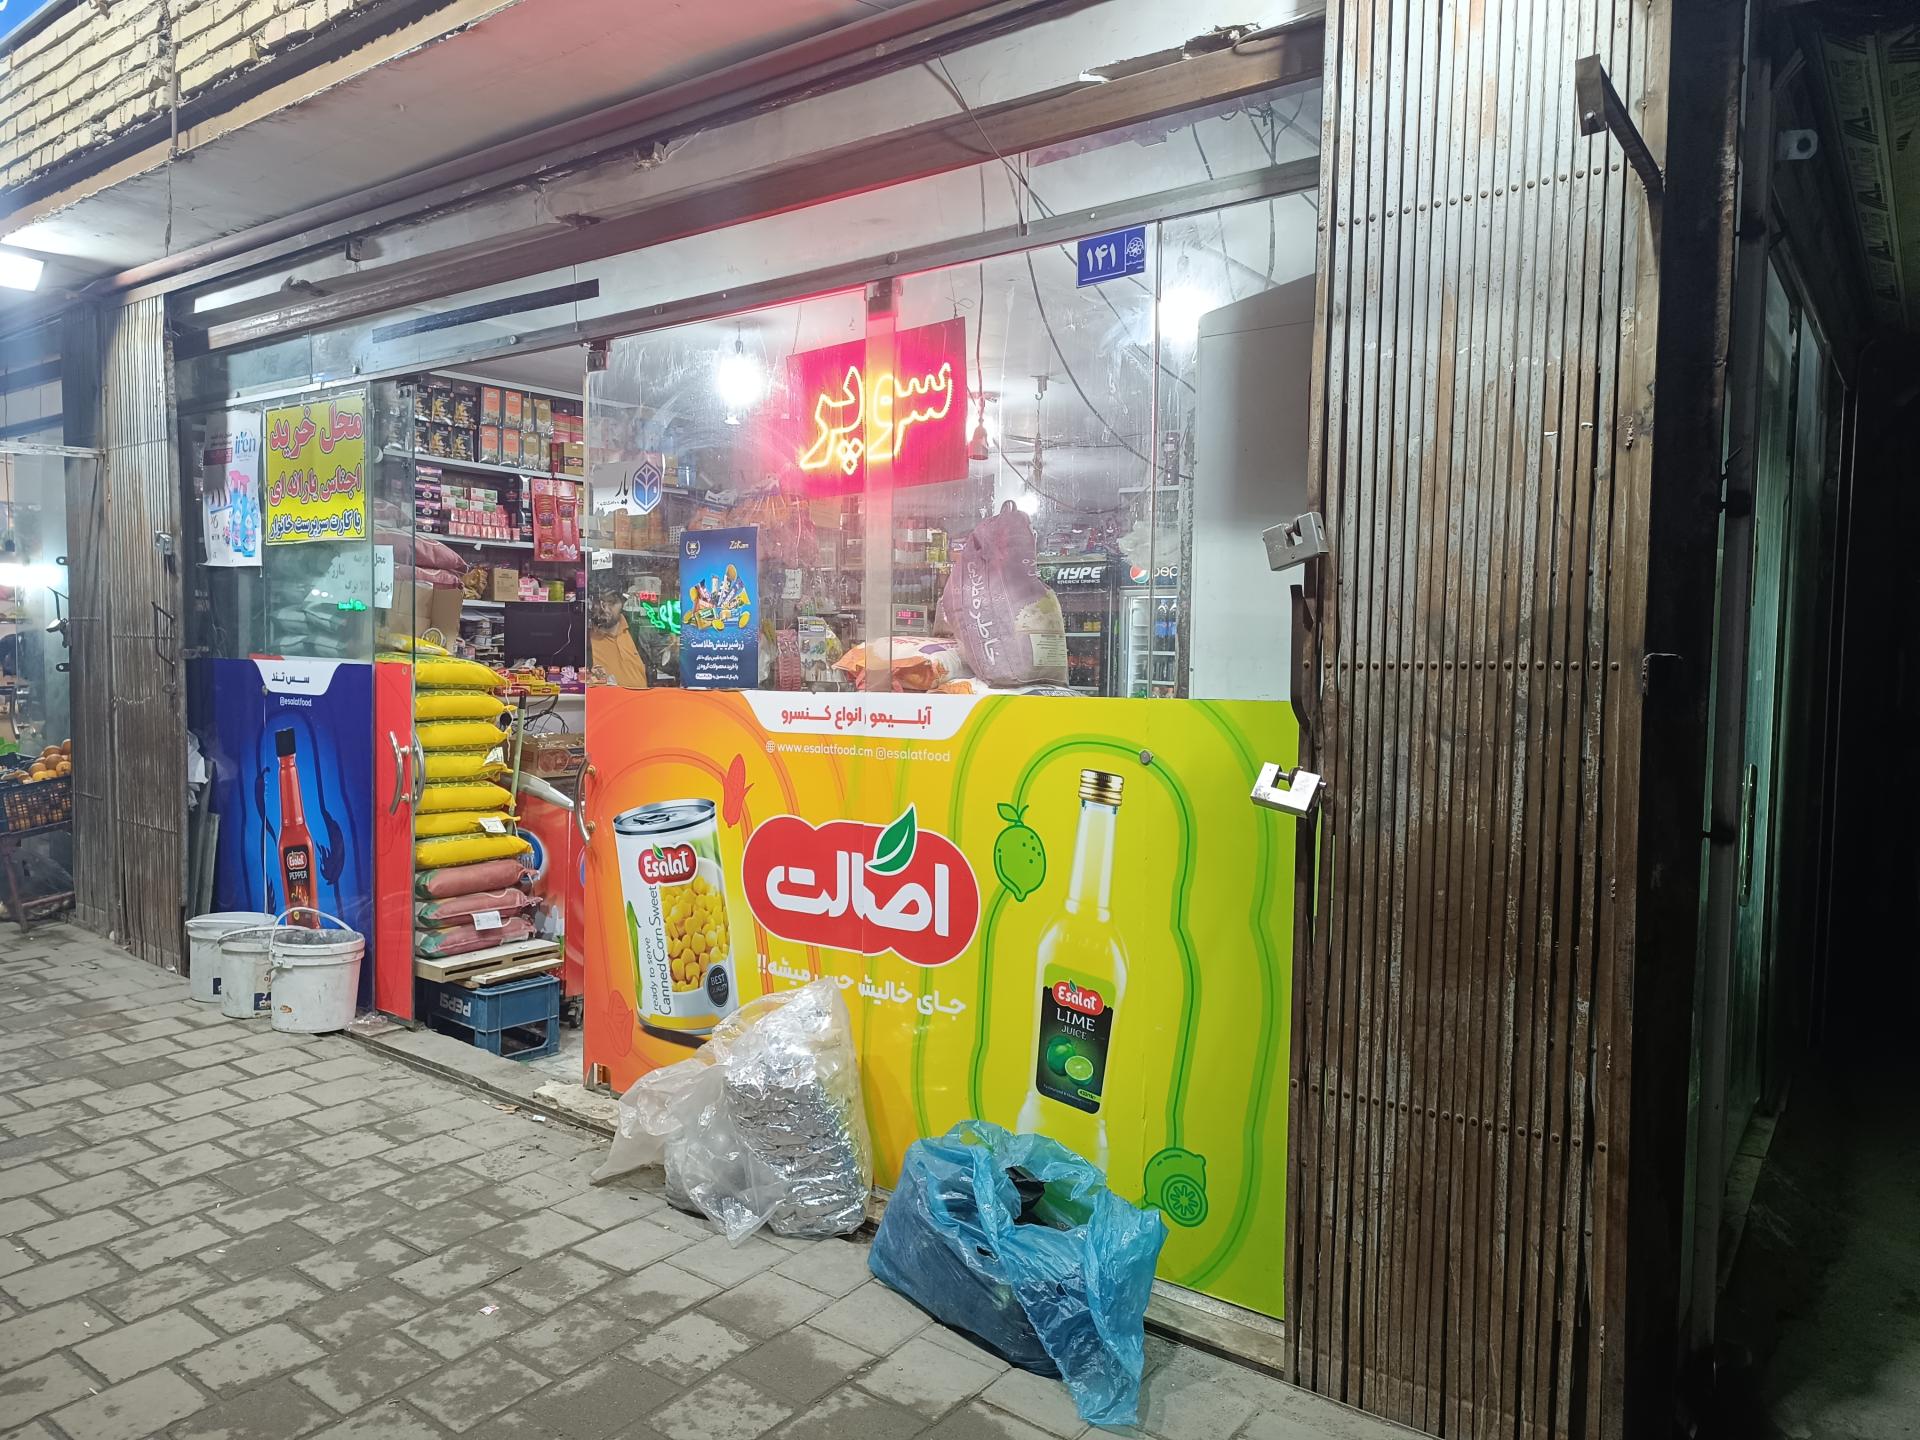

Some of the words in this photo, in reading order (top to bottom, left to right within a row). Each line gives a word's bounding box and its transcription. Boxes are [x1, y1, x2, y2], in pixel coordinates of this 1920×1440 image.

[1087, 243, 1116, 272] ۱۴۱
[319, 401, 363, 453] محل
[800, 360, 953, 475] سوپر
[270, 405, 316, 458] خرید
[269, 470, 286, 507] ای
[287, 468, 319, 504] یارانه
[320, 463, 362, 502] اجناس
[268, 513, 294, 540] خانوار
[294, 516, 330, 537] سرپرست
[330, 509, 353, 536] کارت
[353, 508, 362, 534] با
[1057, 567, 1103, 579] HYPE
[1152, 566, 1178, 579] pep
[271, 671, 285, 684] تند
[286, 676, 310, 685] سس
[279, 696, 312, 707] @esalatfood
[781, 705, 831, 724] کنسرو
[834, 706, 862, 729] انواع
[869, 706, 932, 729] آبلیمو
[777, 743, 873, 757] www.esalatfood.cm
[289, 870, 307, 880] PEPPER
[643, 850, 690, 879] Esalat
[649, 885, 663, 926] Sweet
[766, 850, 949, 937] اصالت
[645, 937, 653, 965] serve
[652, 927, 666, 962] Corn
[649, 967, 655, 978] to
[710, 973, 725, 986] BEST
[650, 981, 659, 1011] ready
[657, 963, 672, 1015] Canned
[858, 974, 912, 1005] خالیش
[1057, 985, 1097, 1011] Esalat
[917, 990, 966, 1020] جای
[1057, 1008, 1096, 1032] LIME
[1061, 1025, 1087, 1041] JUICE
